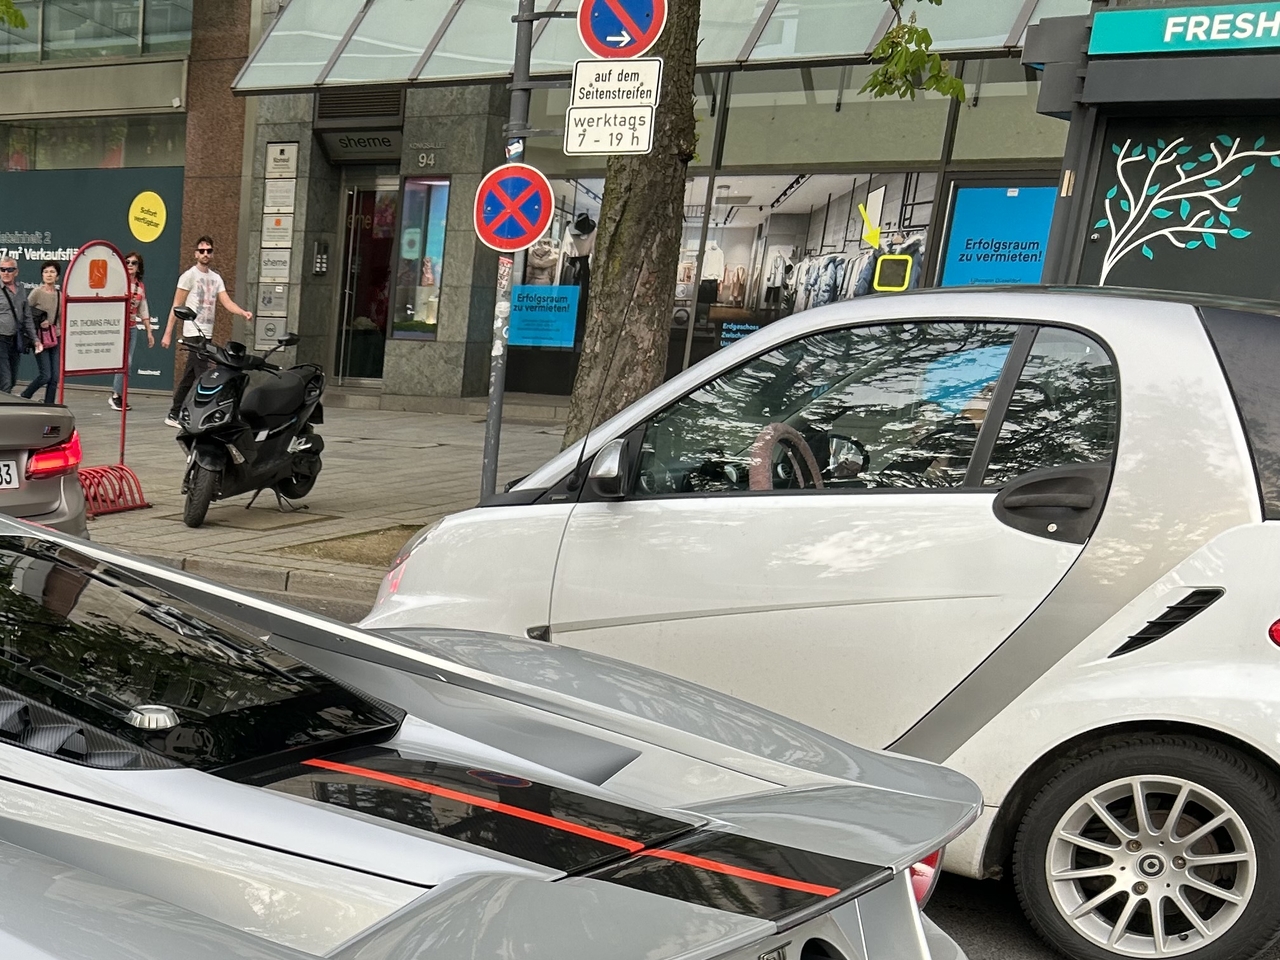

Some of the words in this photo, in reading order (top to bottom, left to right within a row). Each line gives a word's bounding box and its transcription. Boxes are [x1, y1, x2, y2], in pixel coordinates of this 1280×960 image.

[1163, 11, 1280, 43] FRESH
[594, 69, 612, 82] auf
[617, 69, 640, 82] dem
[578, 86, 652, 100] Seitenstreifen
[573, 113, 646, 130] werktags
[338, 135, 392, 149] sheme
[578, 133, 586, 147] 7
[609, 132, 623, 147] 19
[631, 132, 640, 146] h
[418, 153, 436, 167] 94
[43, 231, 52, 244] 2
[965, 238, 1039, 253] Erfolgsraum
[959, 254, 973, 262] zu
[976, 251, 1042, 263] vermieten!
[517, 293, 568, 305] Erfolgsraum
[525, 304, 570, 313] vermieten!
[80, 319, 102, 327] THOMAS
[722, 323, 759, 331] Erdgeschoss
